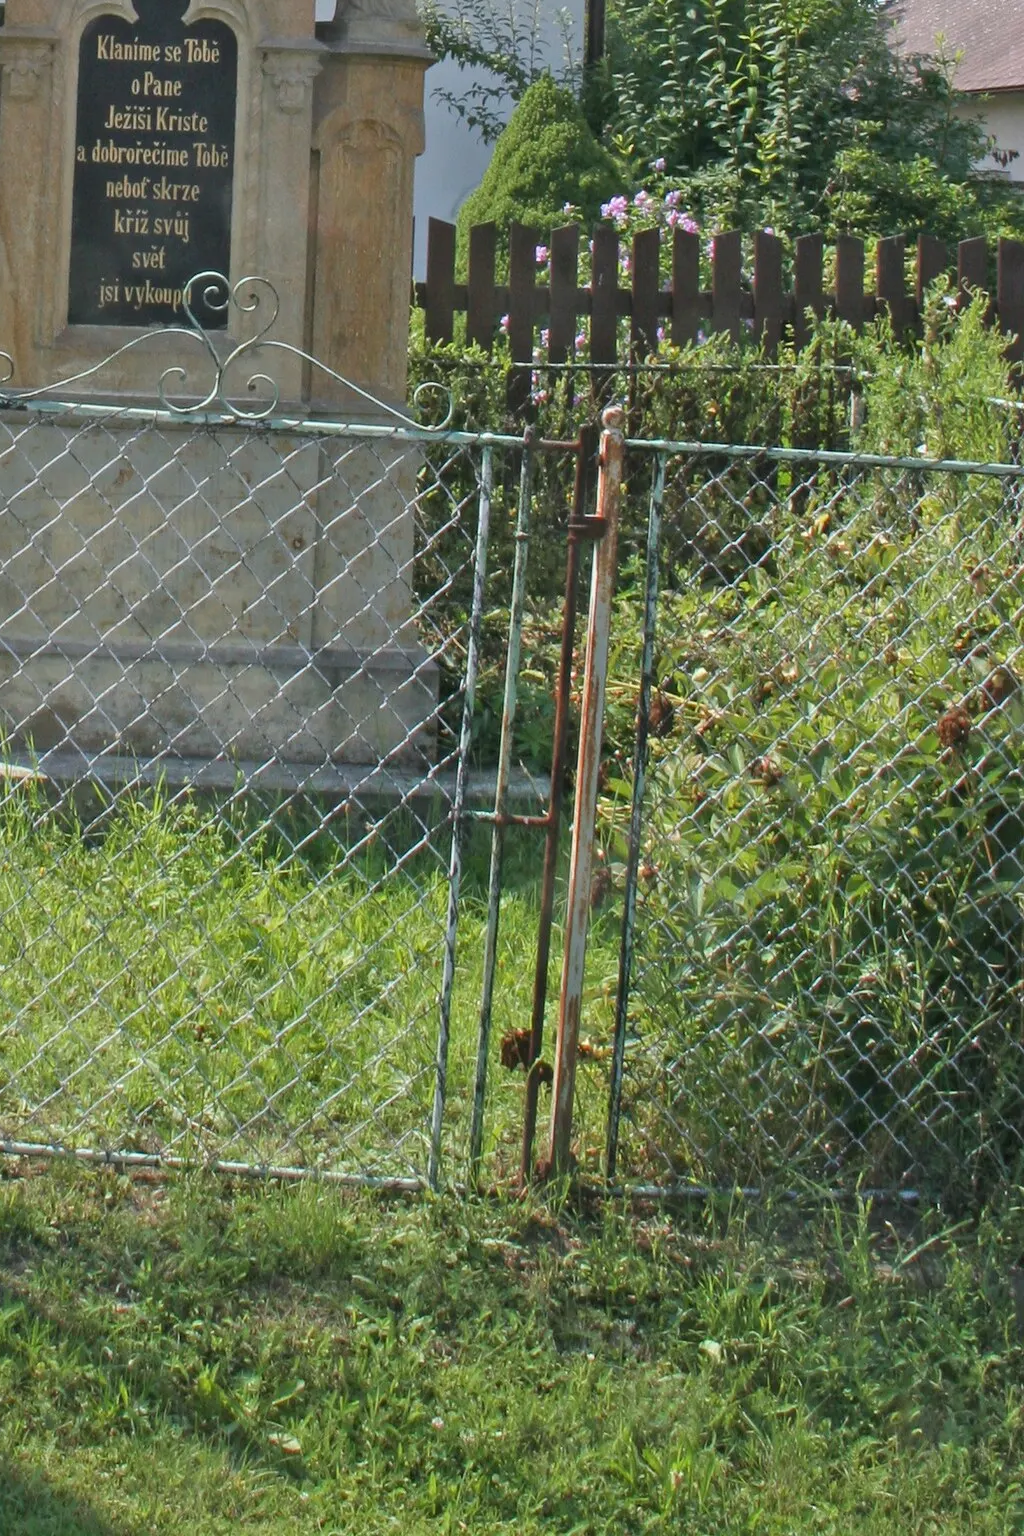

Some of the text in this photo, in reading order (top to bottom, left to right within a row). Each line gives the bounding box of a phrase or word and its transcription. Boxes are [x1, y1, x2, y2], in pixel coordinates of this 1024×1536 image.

[97, 35, 220, 63] Klaníme se Tobě
[131, 71, 182, 96] o Pane
[105, 105, 208, 132] Ježiši Kriste
[77, 139, 229, 168] a dobrořečíme Tobě
[106, 174, 200, 201] neboť skrze
[114, 209, 189, 243] kříž svůj
[132, 245, 166, 270] svět
[98, 277, 119, 308] jsi
